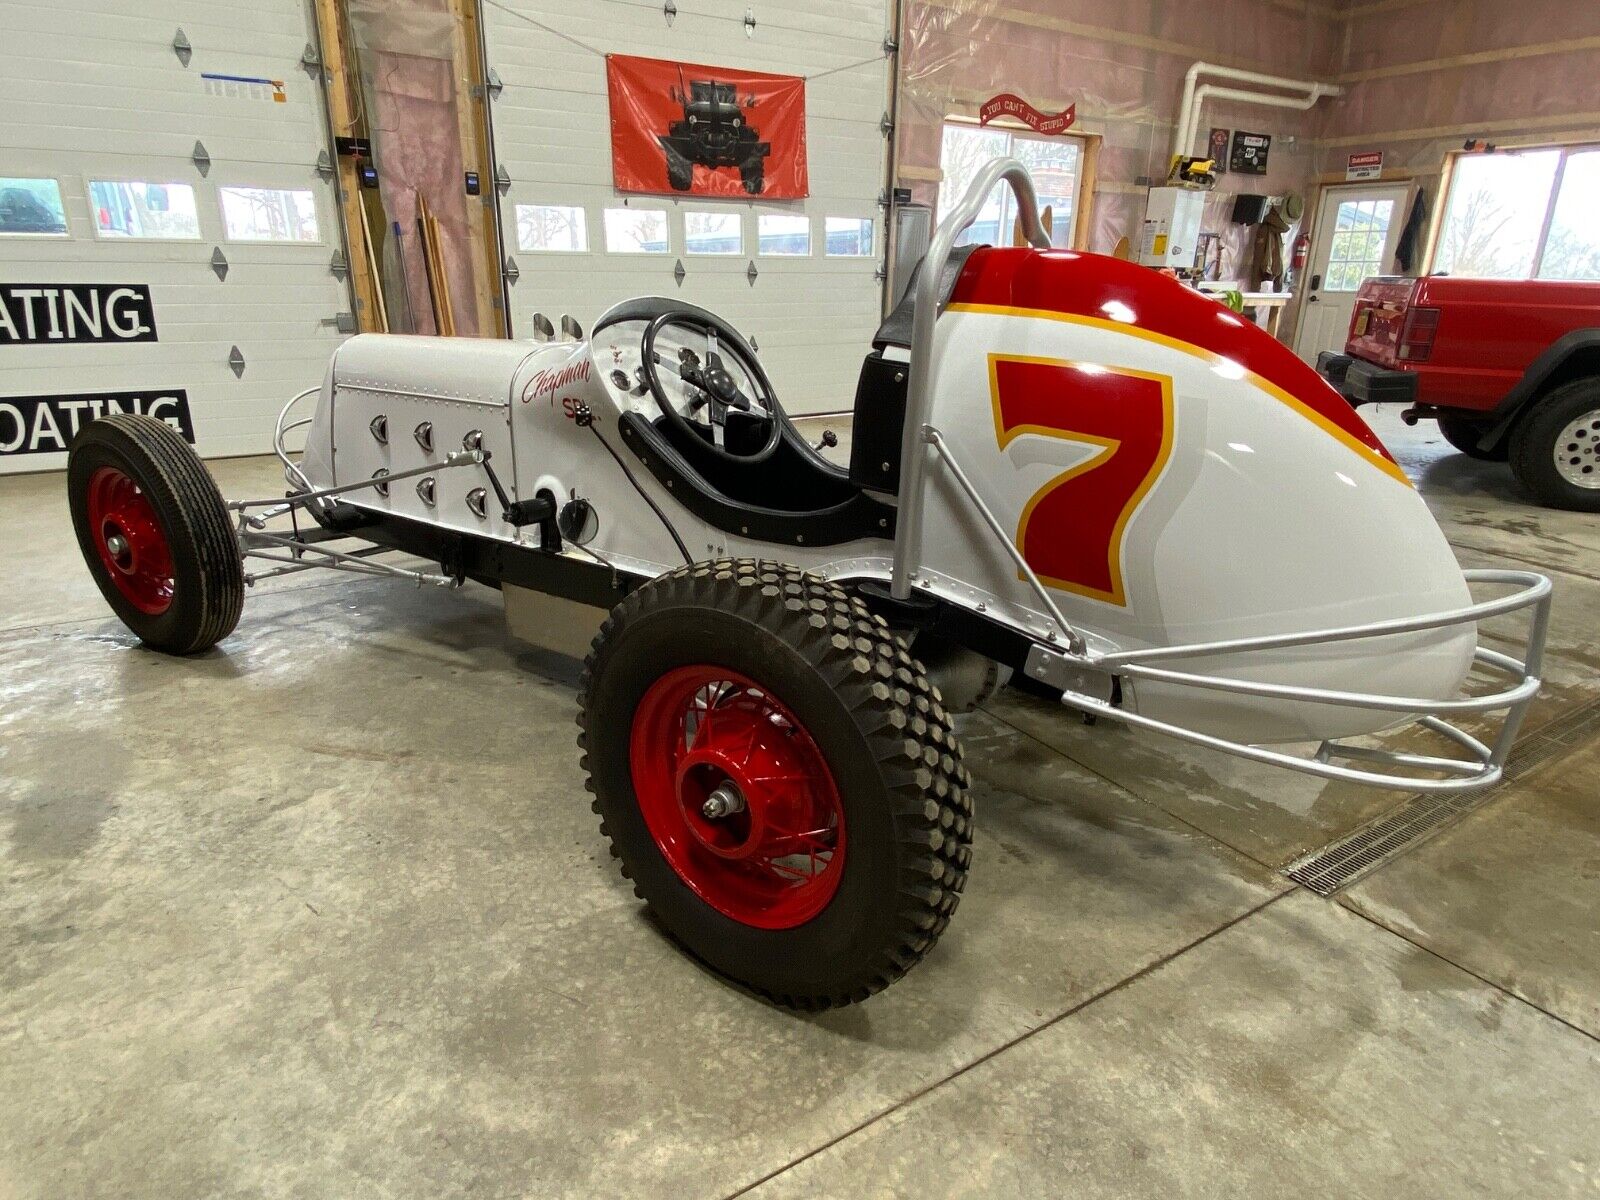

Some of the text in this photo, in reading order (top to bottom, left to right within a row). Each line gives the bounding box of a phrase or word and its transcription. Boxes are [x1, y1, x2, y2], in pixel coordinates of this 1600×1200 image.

[987, 101, 1001, 114] YOU
[1025, 113, 1038, 126] FIX
[1040, 119, 1064, 131] STUPID
[1351, 155, 1379, 164] DANGER
[522, 357, 591, 406] Chapman
[987, 353, 1175, 607] 7
